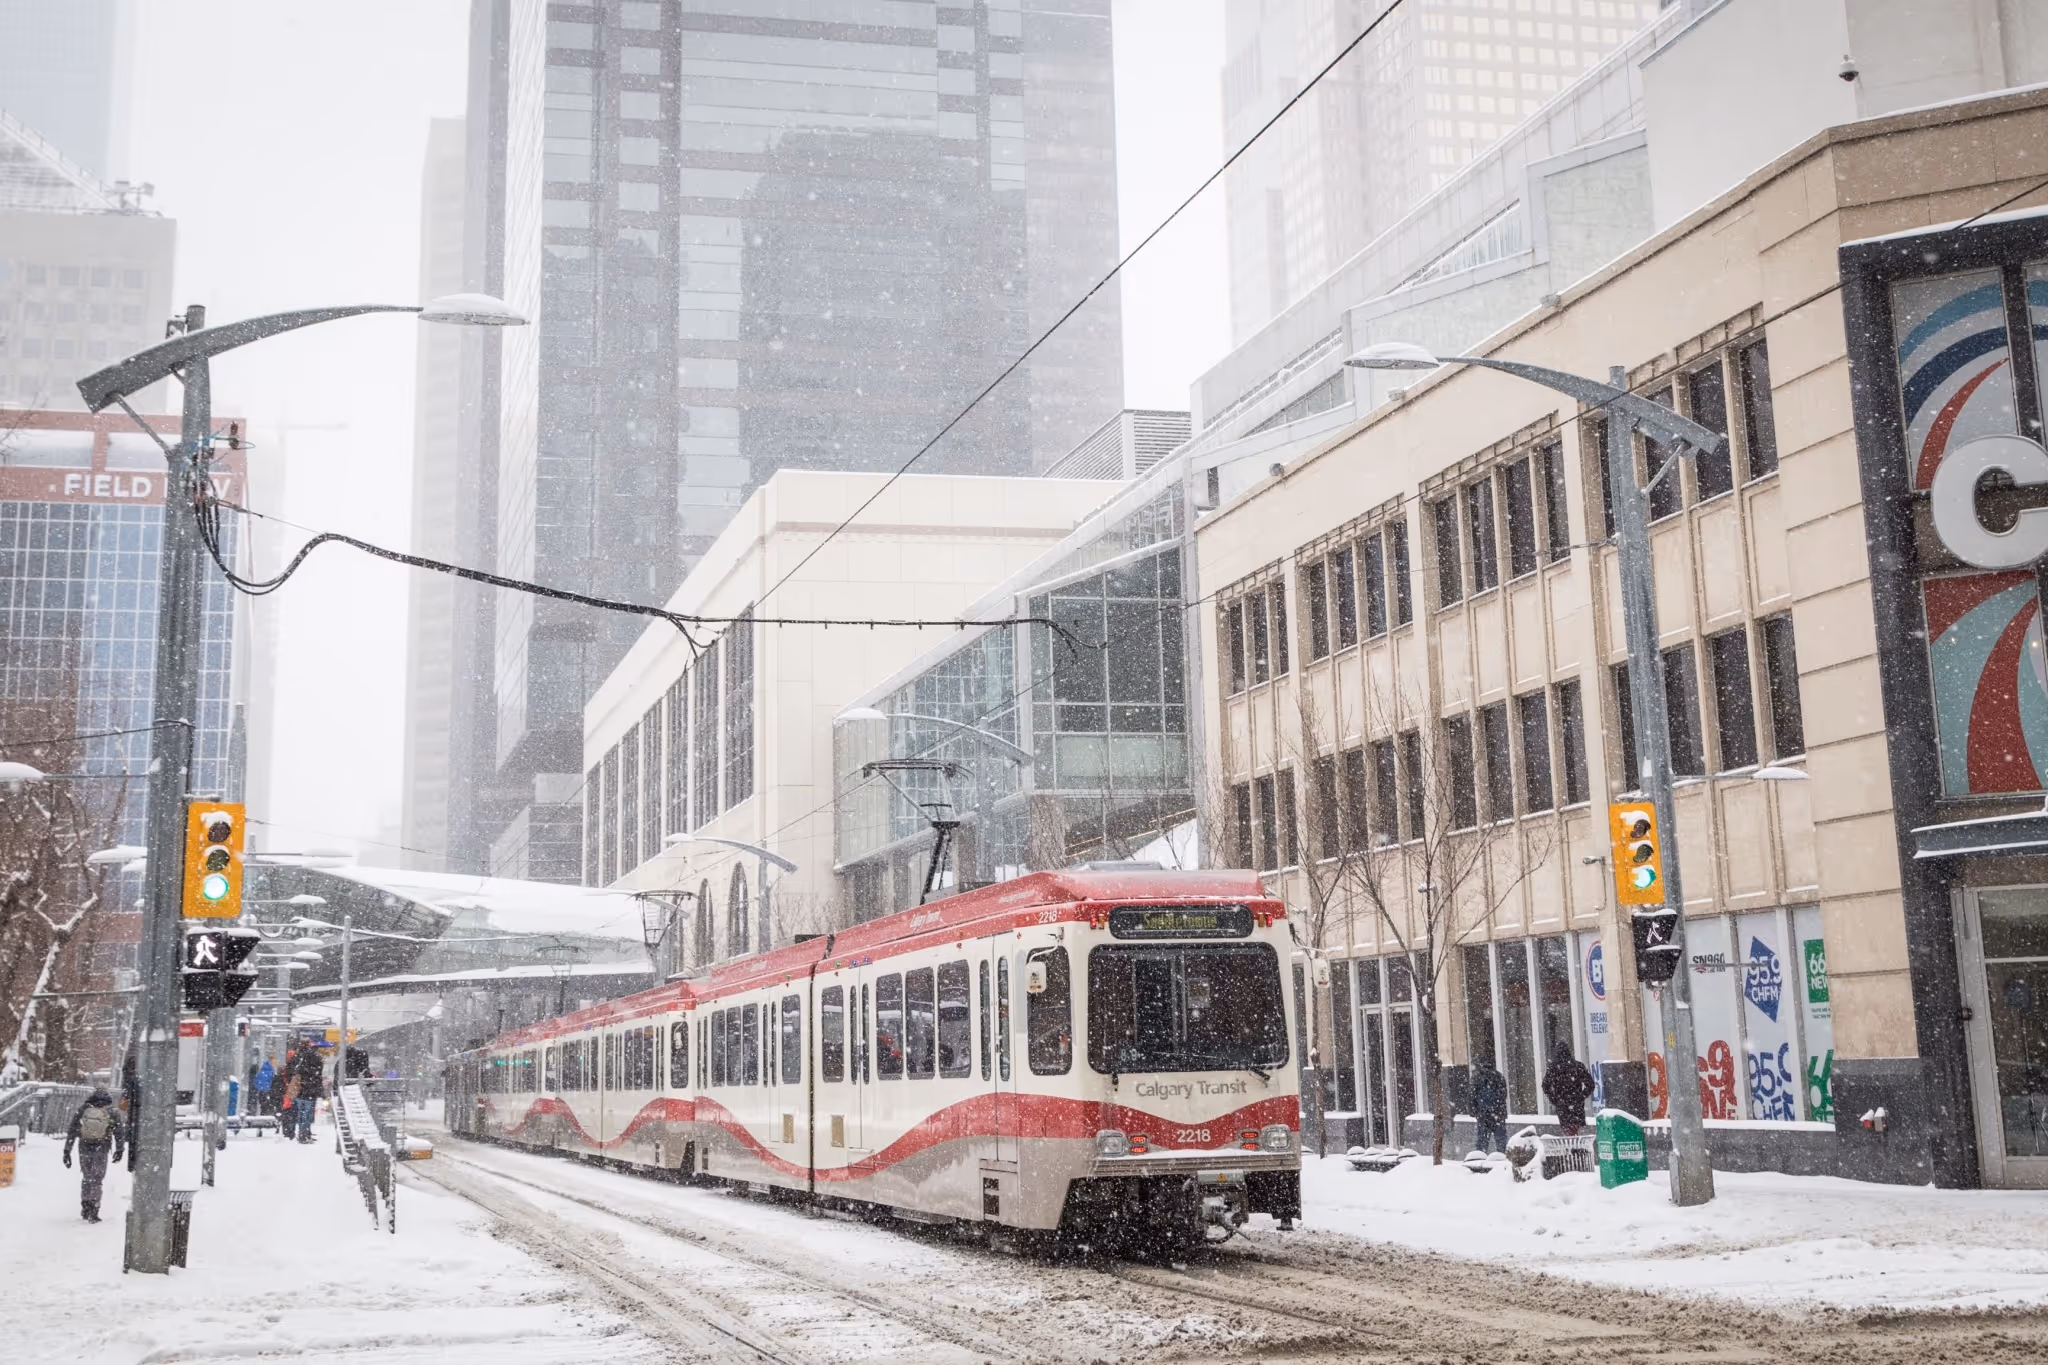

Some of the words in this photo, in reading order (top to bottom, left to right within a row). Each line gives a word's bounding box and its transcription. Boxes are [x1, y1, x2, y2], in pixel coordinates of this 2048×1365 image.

[64, 473, 152, 499] FIELD
[1039, 909, 1058, 924] 2218
[1749, 955, 1782, 985] 95.9
[1751, 986, 1780, 1001] CHFM
[1136, 1081, 1193, 1100] Calgary
[1197, 1078, 1247, 1095] Transit
[1177, 1129, 1212, 1143] 2218
